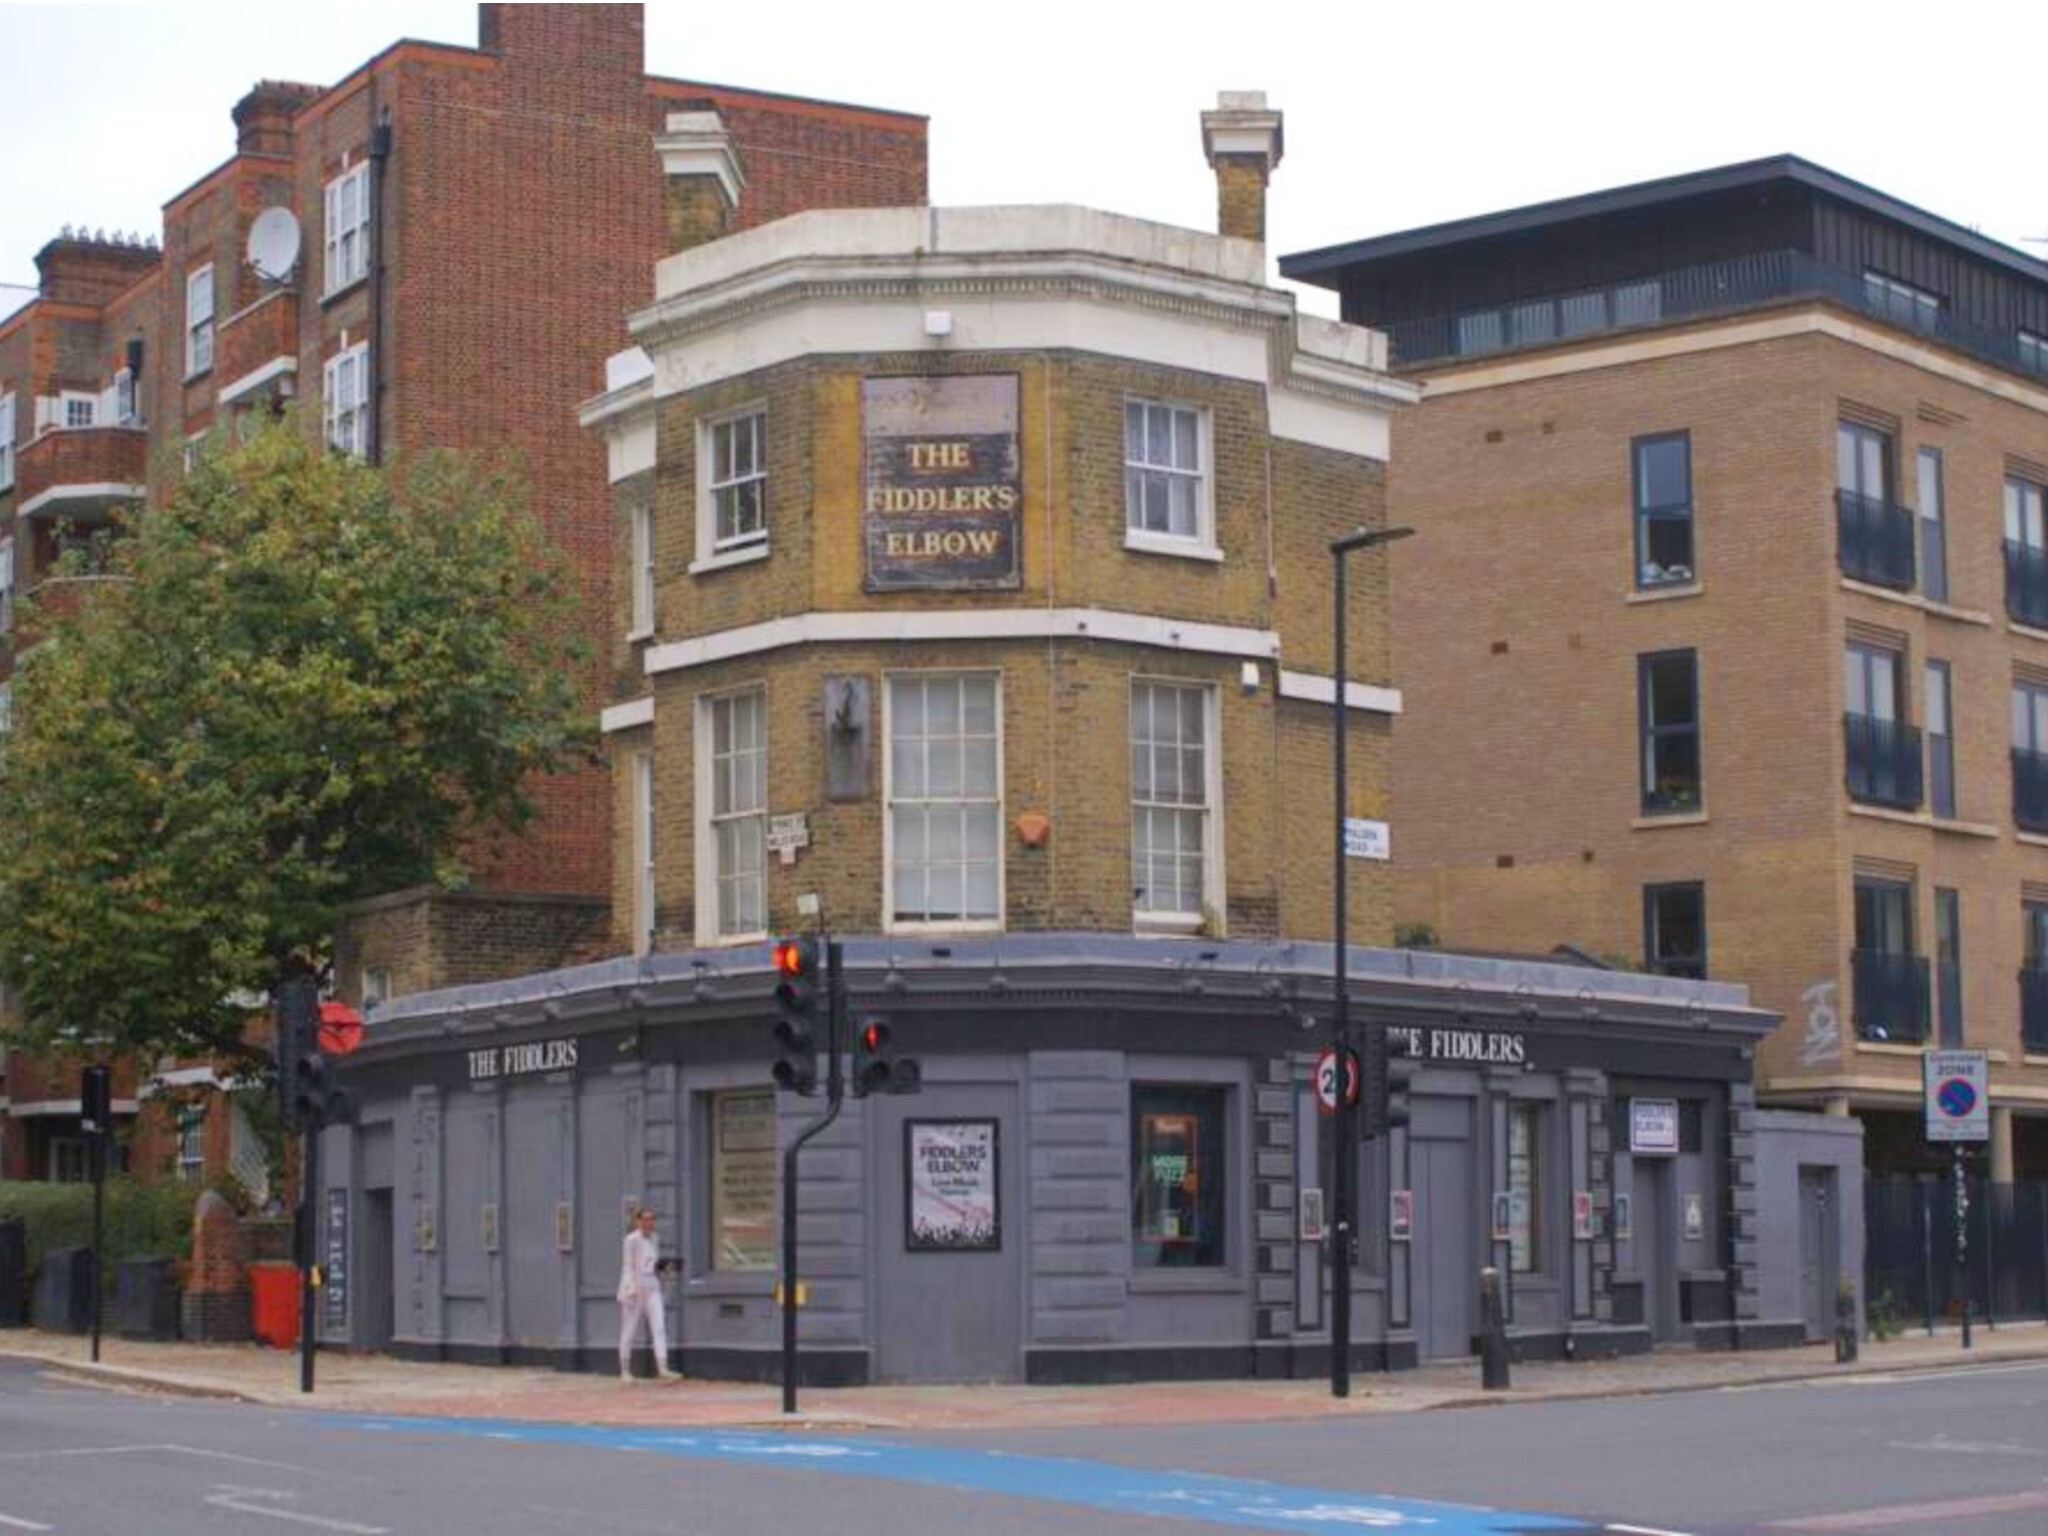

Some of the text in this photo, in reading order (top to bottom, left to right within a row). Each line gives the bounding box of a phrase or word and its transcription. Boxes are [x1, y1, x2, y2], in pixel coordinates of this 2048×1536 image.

[908, 442, 970, 468] THE
[867, 486, 1017, 512] FIDDLER'S
[886, 530, 999, 556] ELBOW
[468, 1038, 578, 1078] THE FIDDLERS
[1431, 1030, 1524, 1062] FIDDLERS
[1937, 1065, 1974, 1076] ZONE
[920, 1145, 986, 1159] FIDDLERS
[927, 1160, 980, 1173] ELBOW
